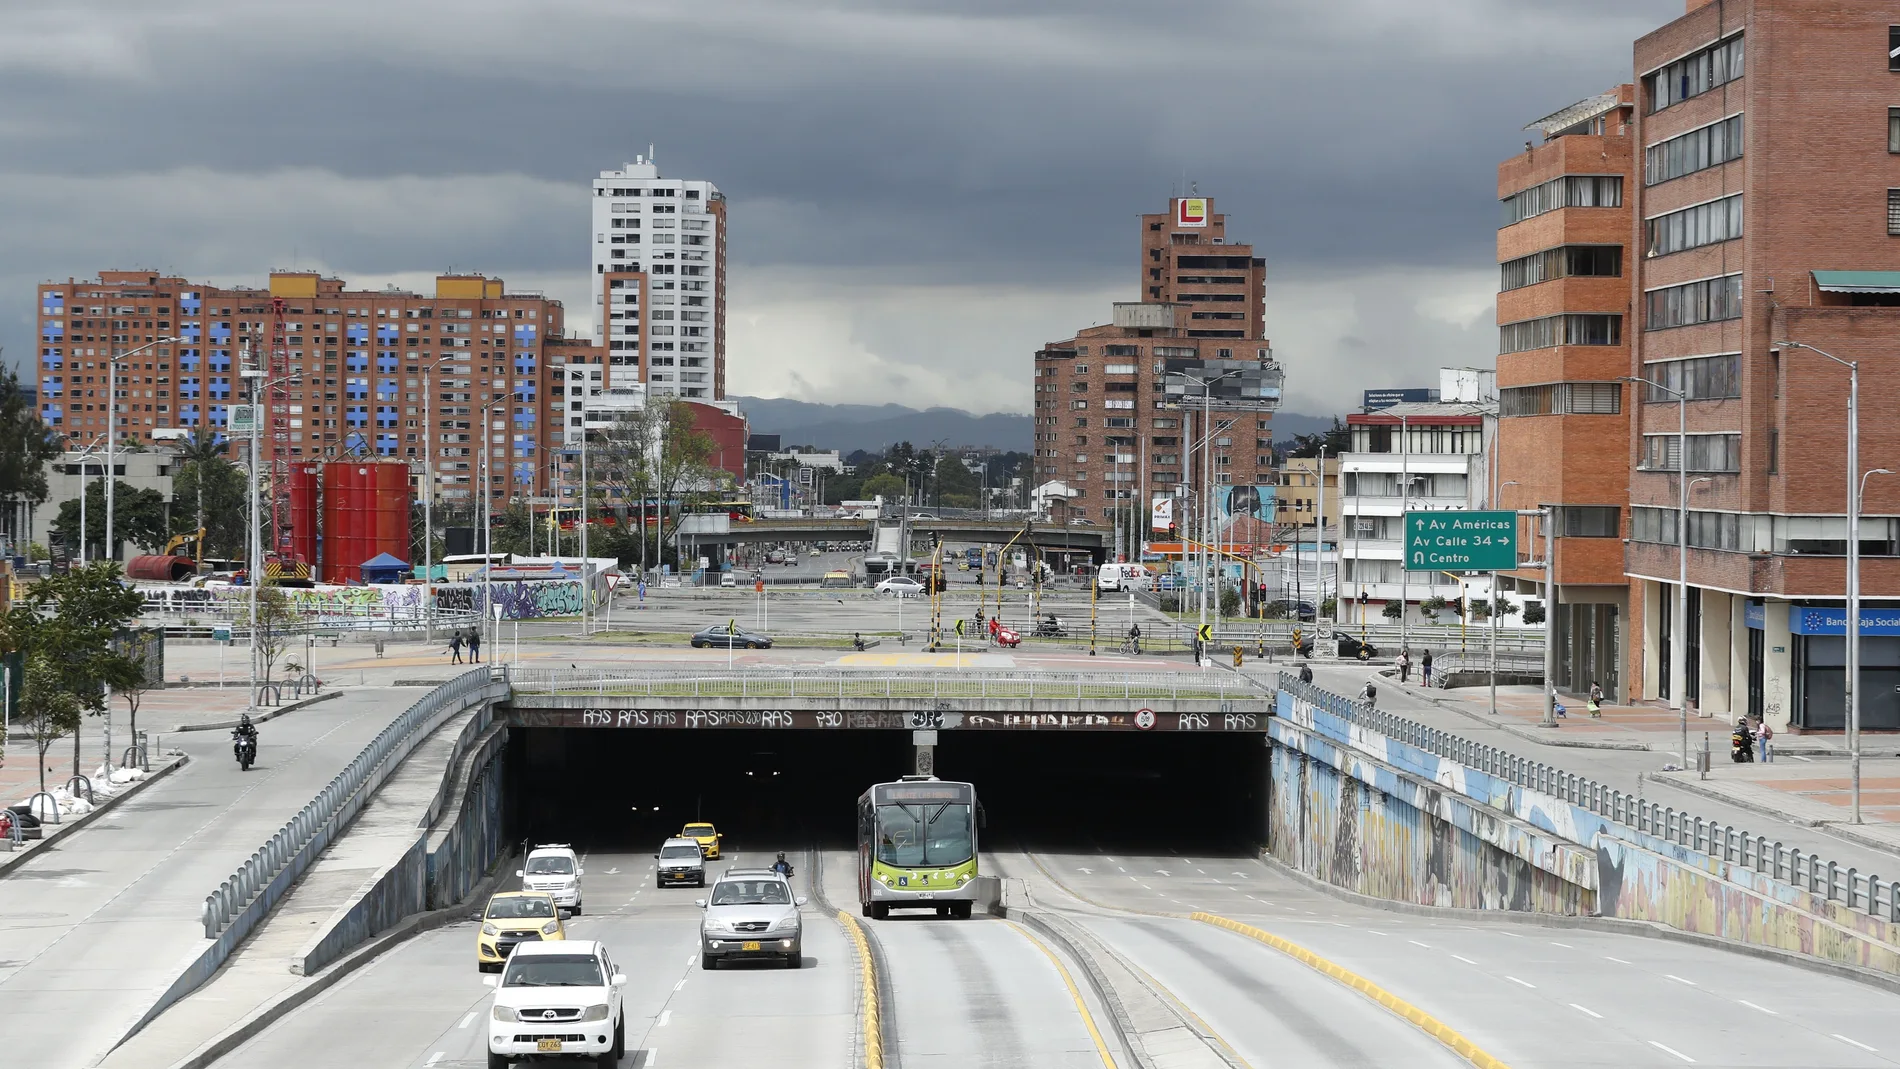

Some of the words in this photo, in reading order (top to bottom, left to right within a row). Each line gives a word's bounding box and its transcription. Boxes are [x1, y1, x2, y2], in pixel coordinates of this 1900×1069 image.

[1429, 519, 1446, 529] Av
[1452, 519, 1510, 529] Américas
[1413, 536, 1430, 546] Av
[1436, 536, 1467, 546] Calle
[1473, 536, 1492, 546] 34
[1429, 553, 1470, 563] Centro
[1120, 567, 1140, 577] FedEx
[1826, 617, 1853, 626] Banc
[583, 709, 612, 726] RAS
[617, 709, 649, 727] RAS
[653, 710, 677, 726] RAS
[685, 709, 719, 728] RAS
[719, 710, 744, 725] RAS
[762, 710, 793, 728] RAS
[1178, 713, 1209, 730] RAS
[1224, 713, 1257, 730] RAS
